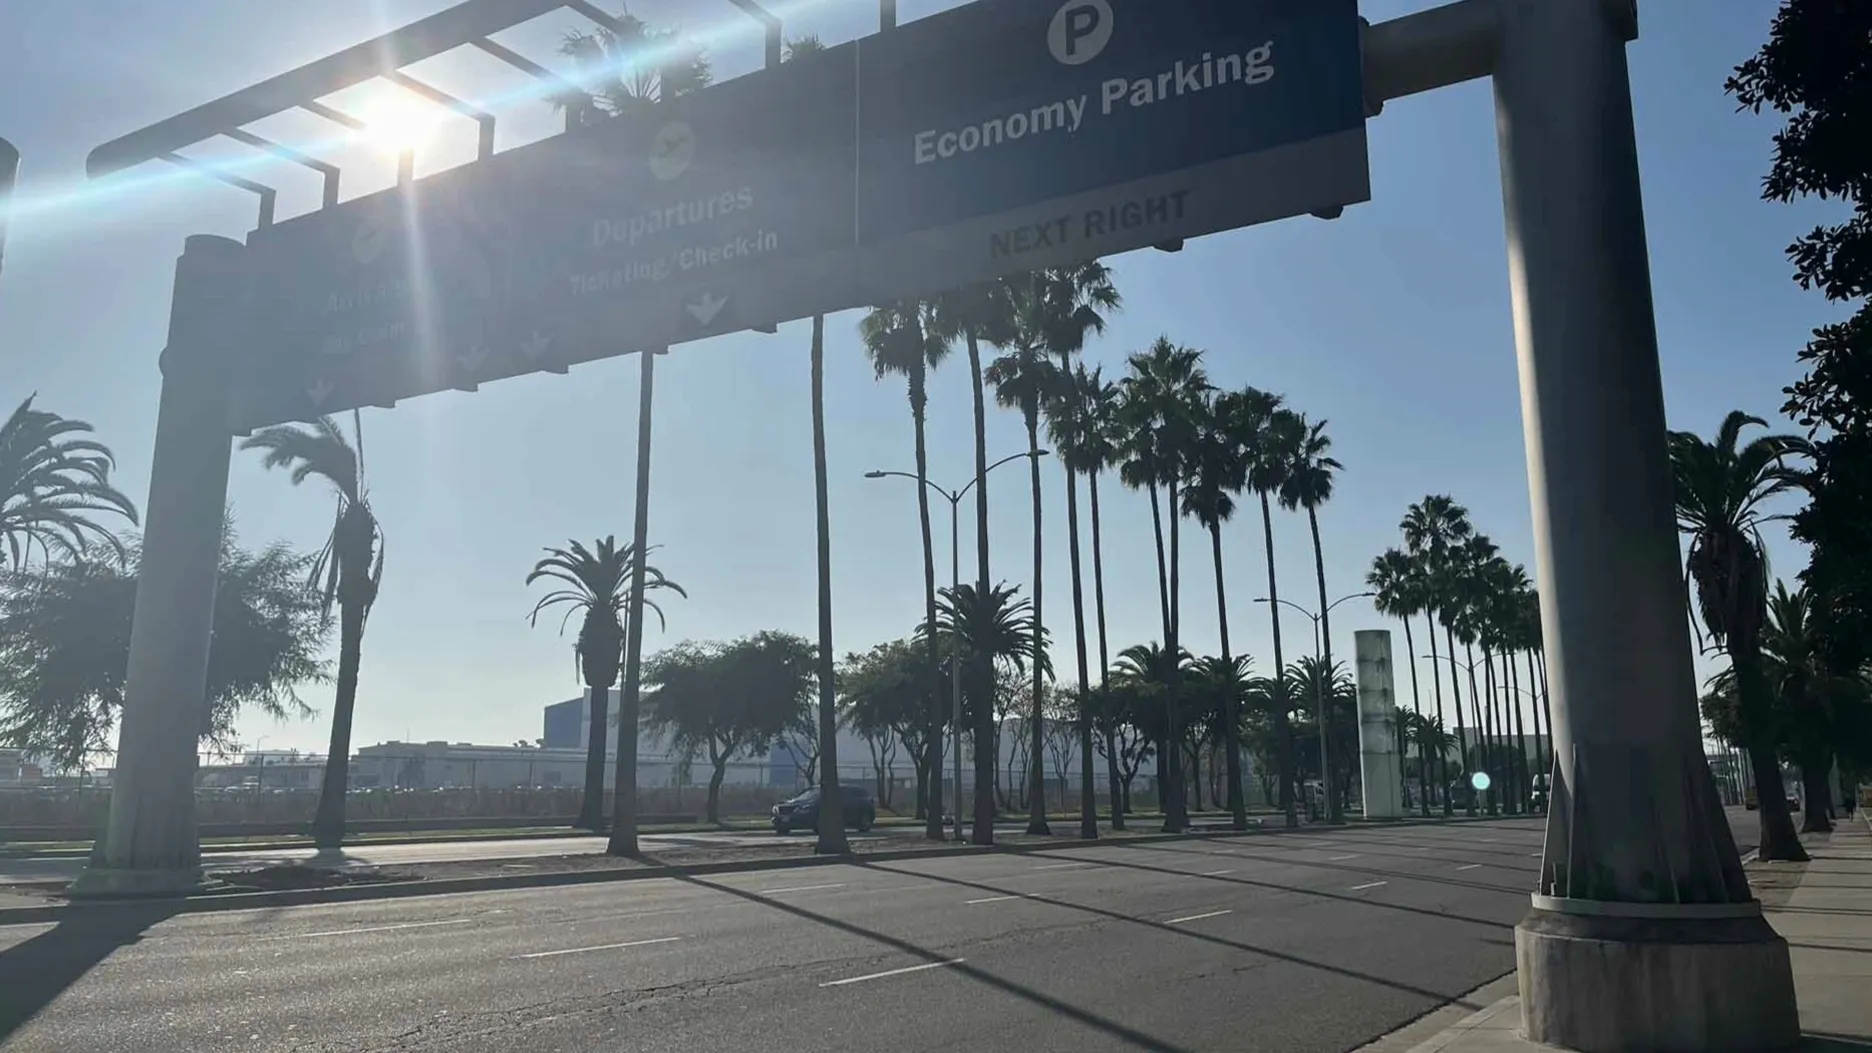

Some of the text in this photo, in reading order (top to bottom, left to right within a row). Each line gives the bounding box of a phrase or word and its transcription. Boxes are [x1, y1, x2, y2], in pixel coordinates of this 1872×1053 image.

[914, 39, 1276, 166] Economy Parking
[592, 185, 755, 248] Departures
[990, 189, 1190, 260] NEXT RIGHT
